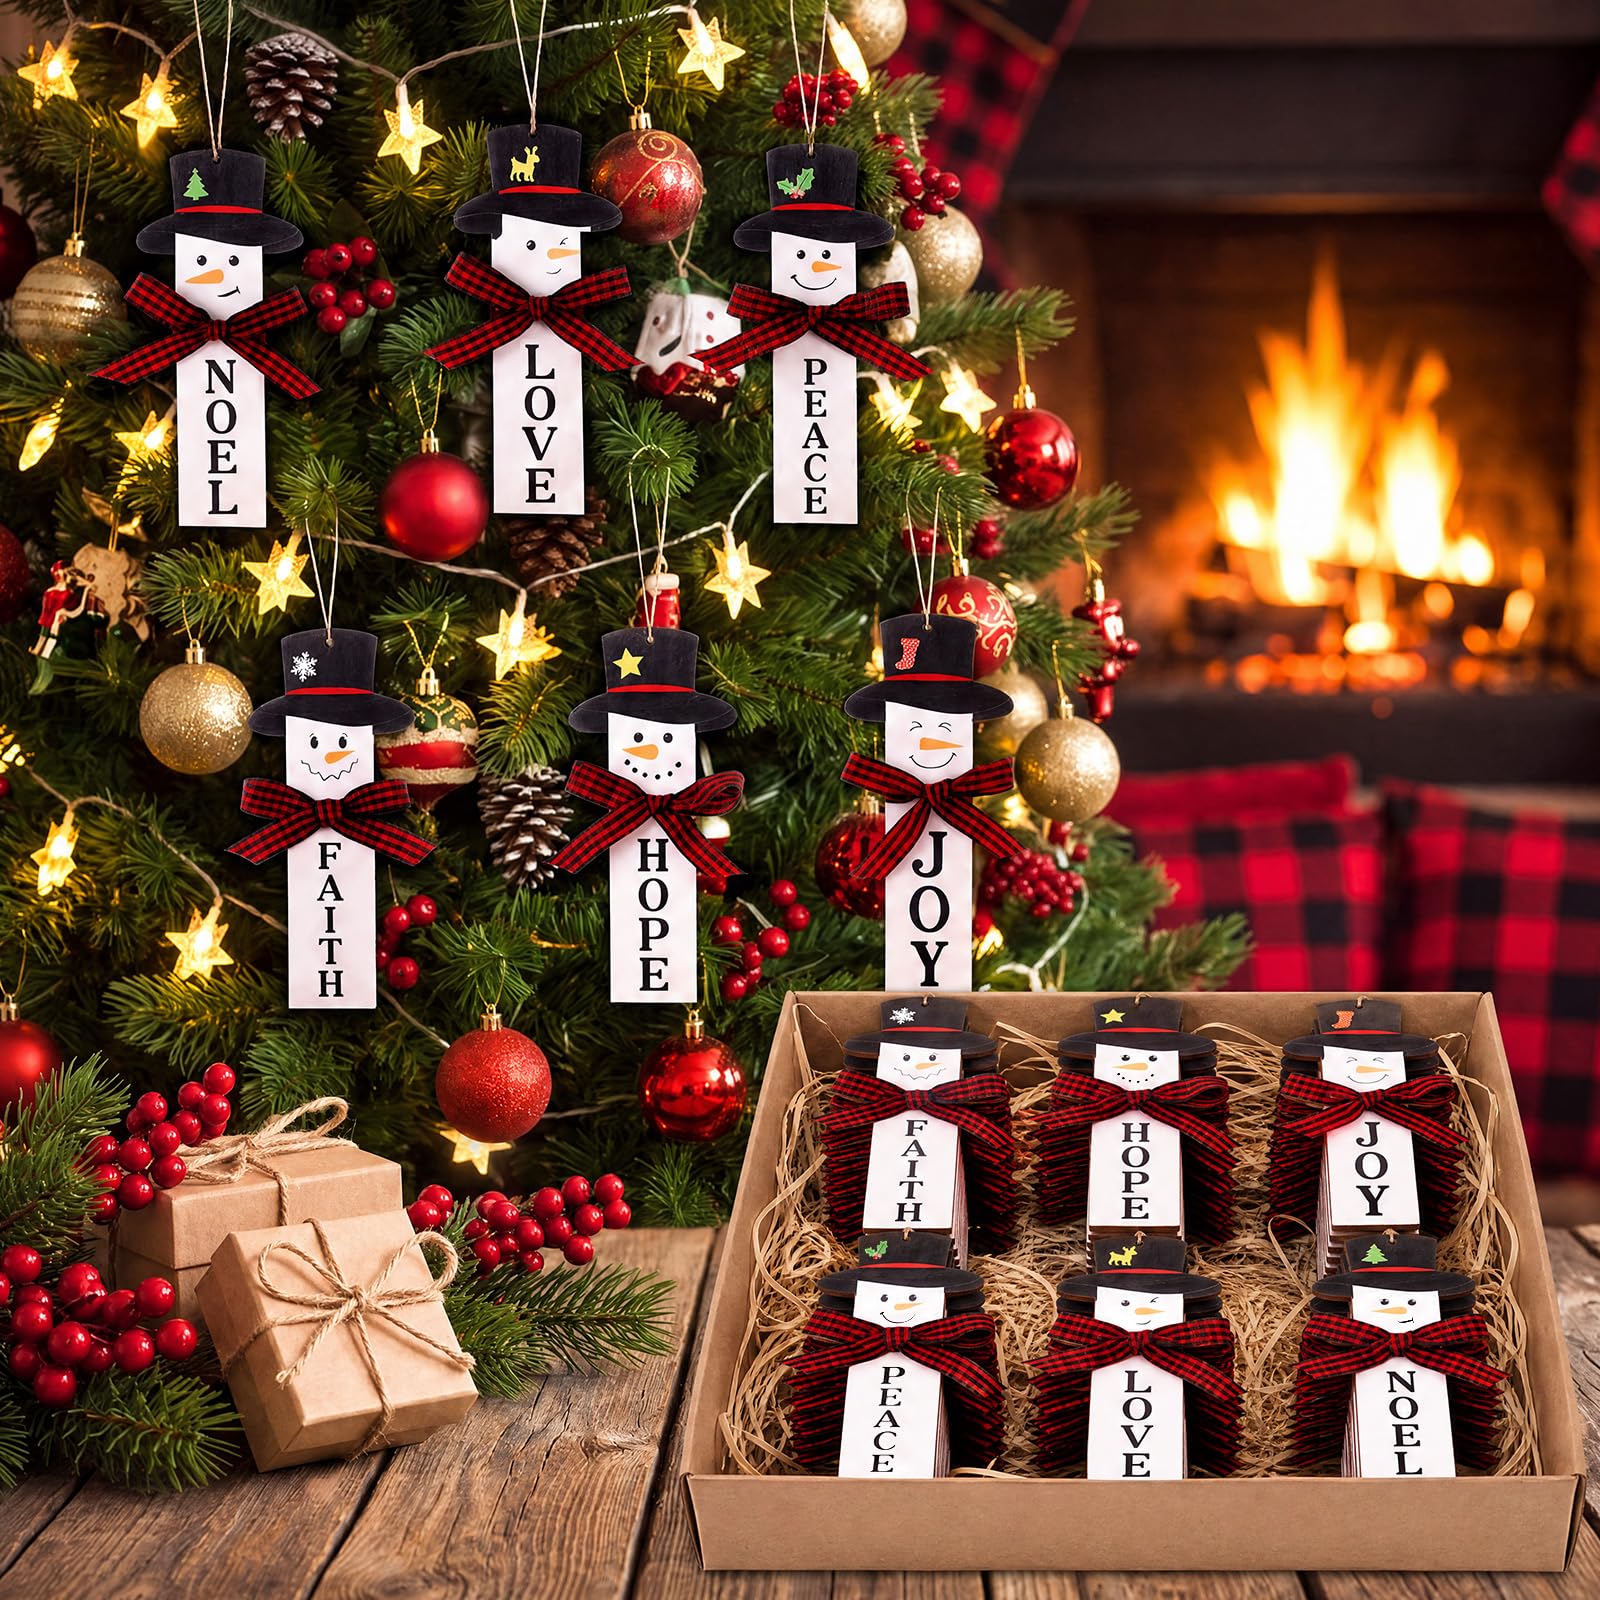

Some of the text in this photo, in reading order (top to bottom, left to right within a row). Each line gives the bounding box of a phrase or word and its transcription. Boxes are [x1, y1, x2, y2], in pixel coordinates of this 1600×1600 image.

[205, 359, 238, 515] NOEL
[521, 344, 558, 504] LOVE
[801, 358, 829, 515] PEACE
[316, 842, 344, 998] FAITH
[637, 838, 670, 992] HOPE
[909, 830, 950, 987] JOY
[894, 1119, 928, 1222] FAITH
[1121, 1122, 1151, 1220] HOPE
[1354, 1121, 1390, 1217] JOY
[870, 1366, 906, 1473] PEACE
[1120, 1370, 1154, 1478] LOVE
[1386, 1370, 1423, 1475] NOEL
